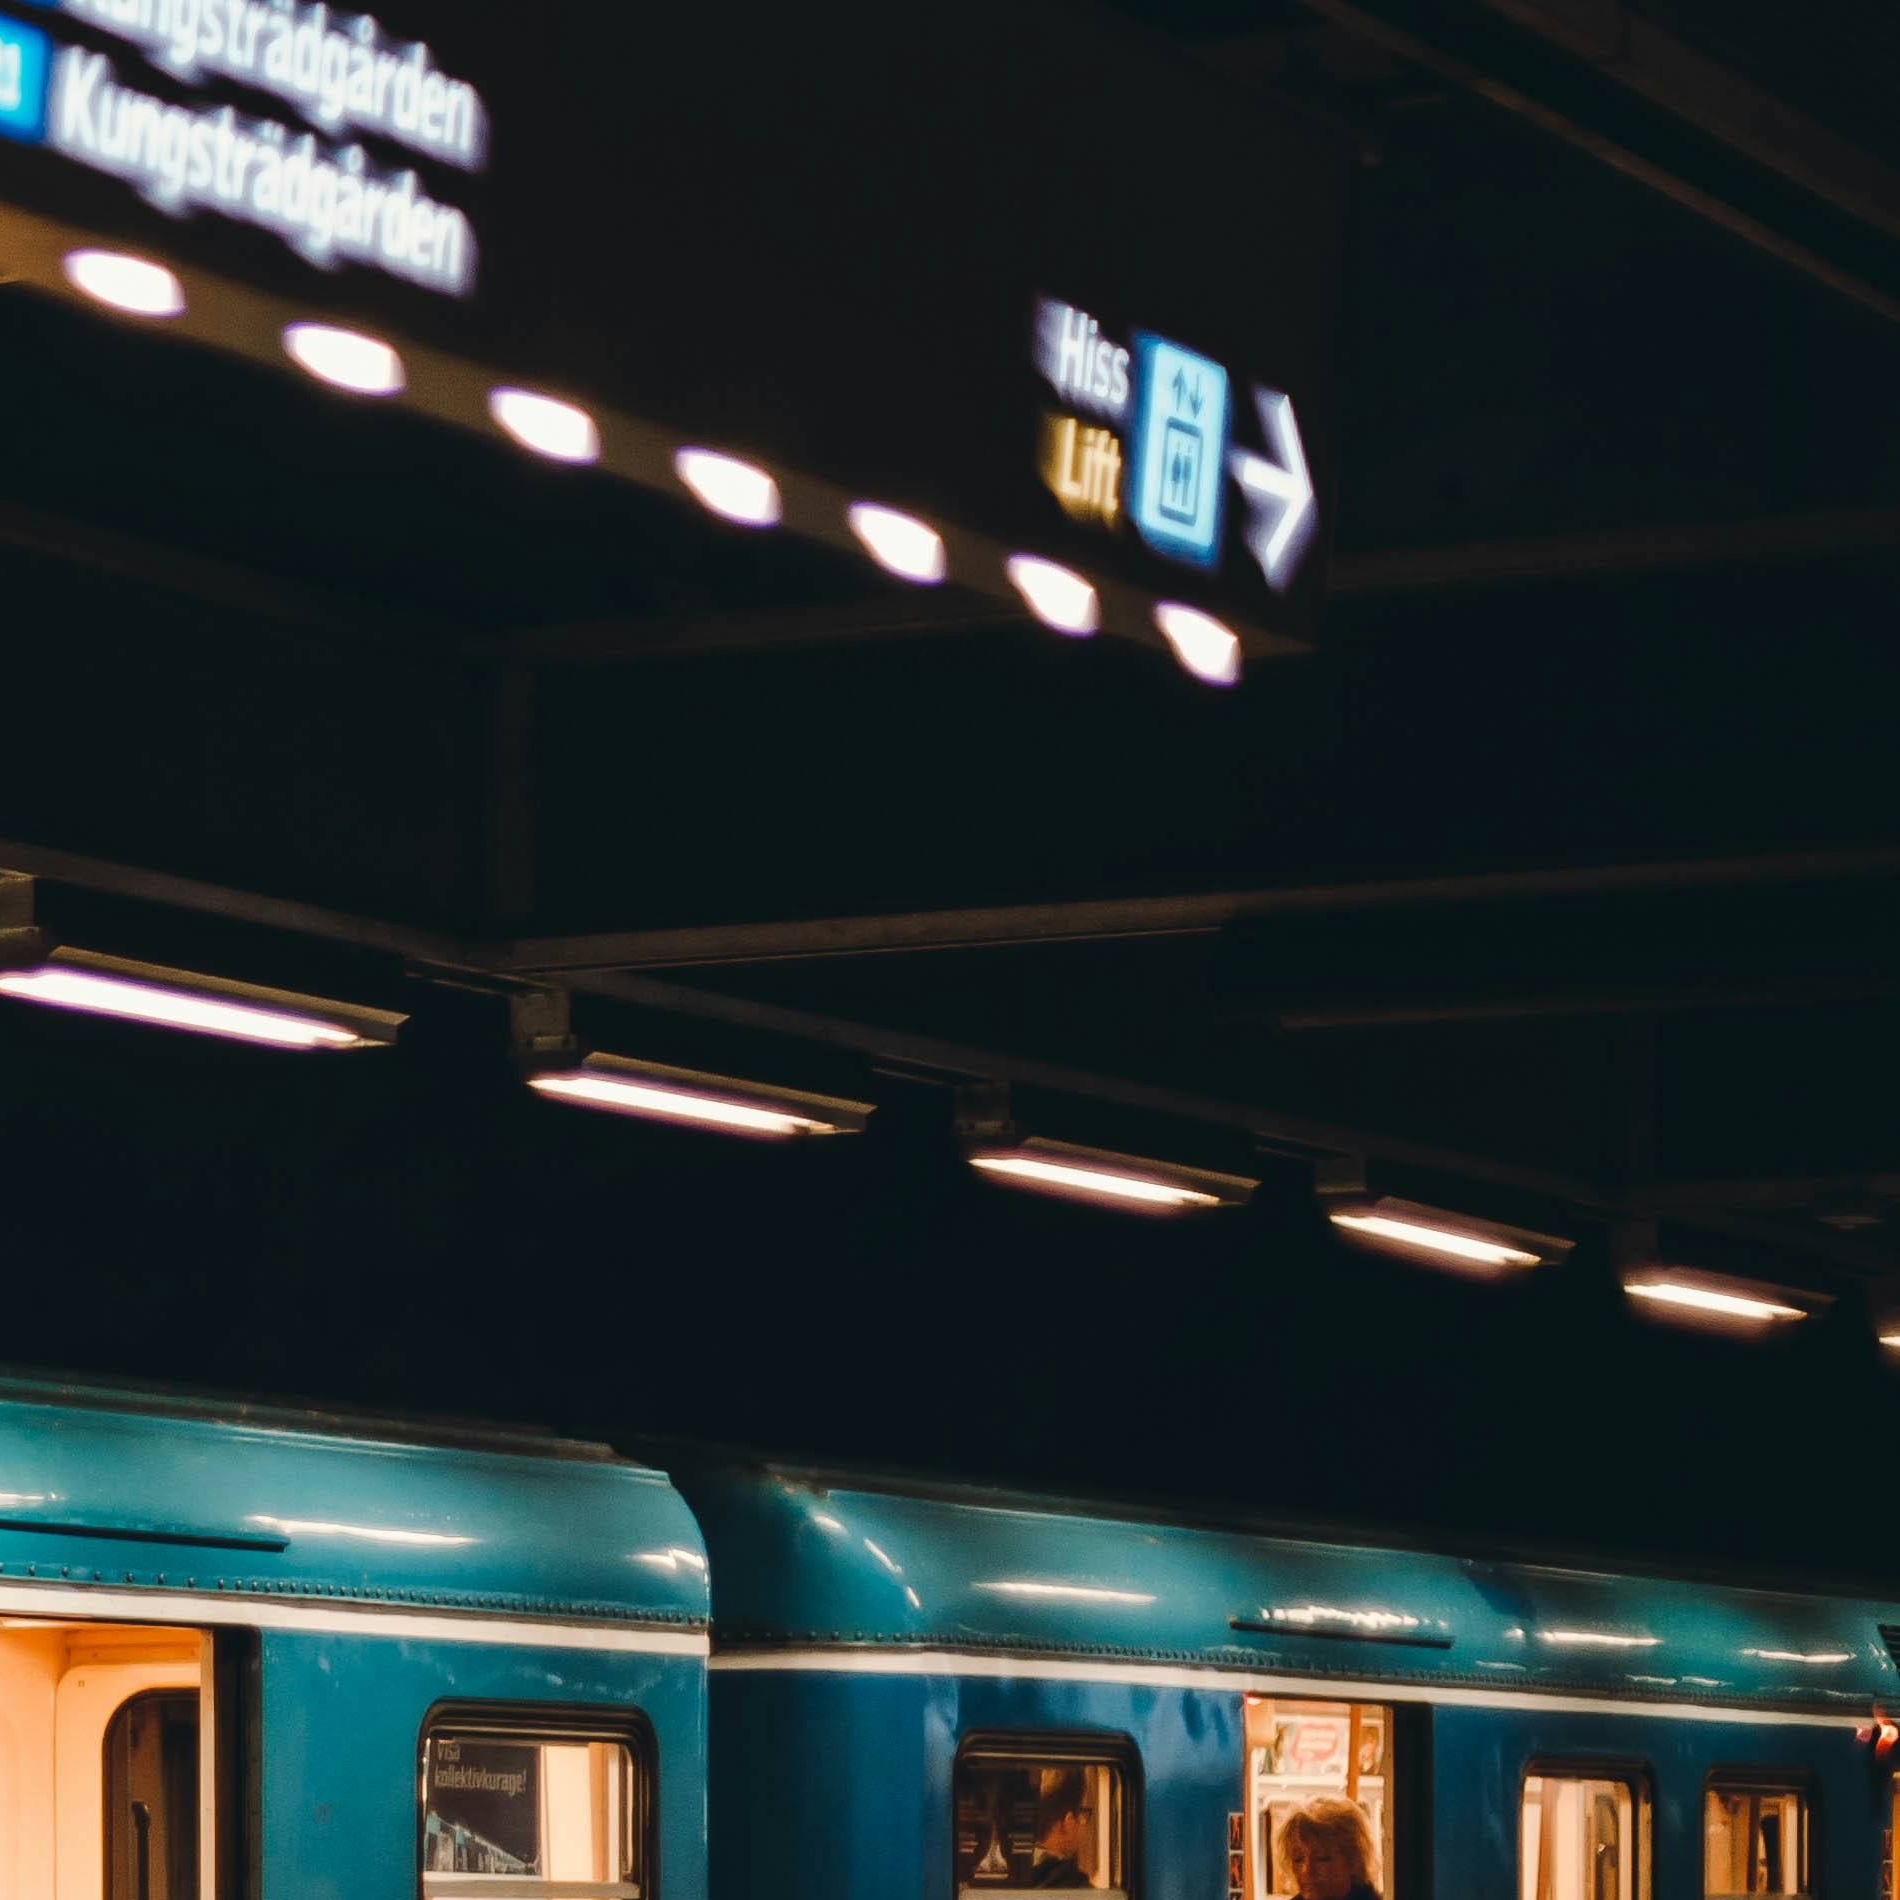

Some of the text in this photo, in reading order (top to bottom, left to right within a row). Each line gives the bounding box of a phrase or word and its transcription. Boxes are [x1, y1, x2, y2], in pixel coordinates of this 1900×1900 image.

[59, 0, 490, 162] ungsträdgården
[57, 44, 474, 284] Kungsträdgården
[1043, 302, 1130, 408] Hiss
[1046, 414, 1122, 517] Lift
[434, 1764, 527, 1798] kollektivkurage!
